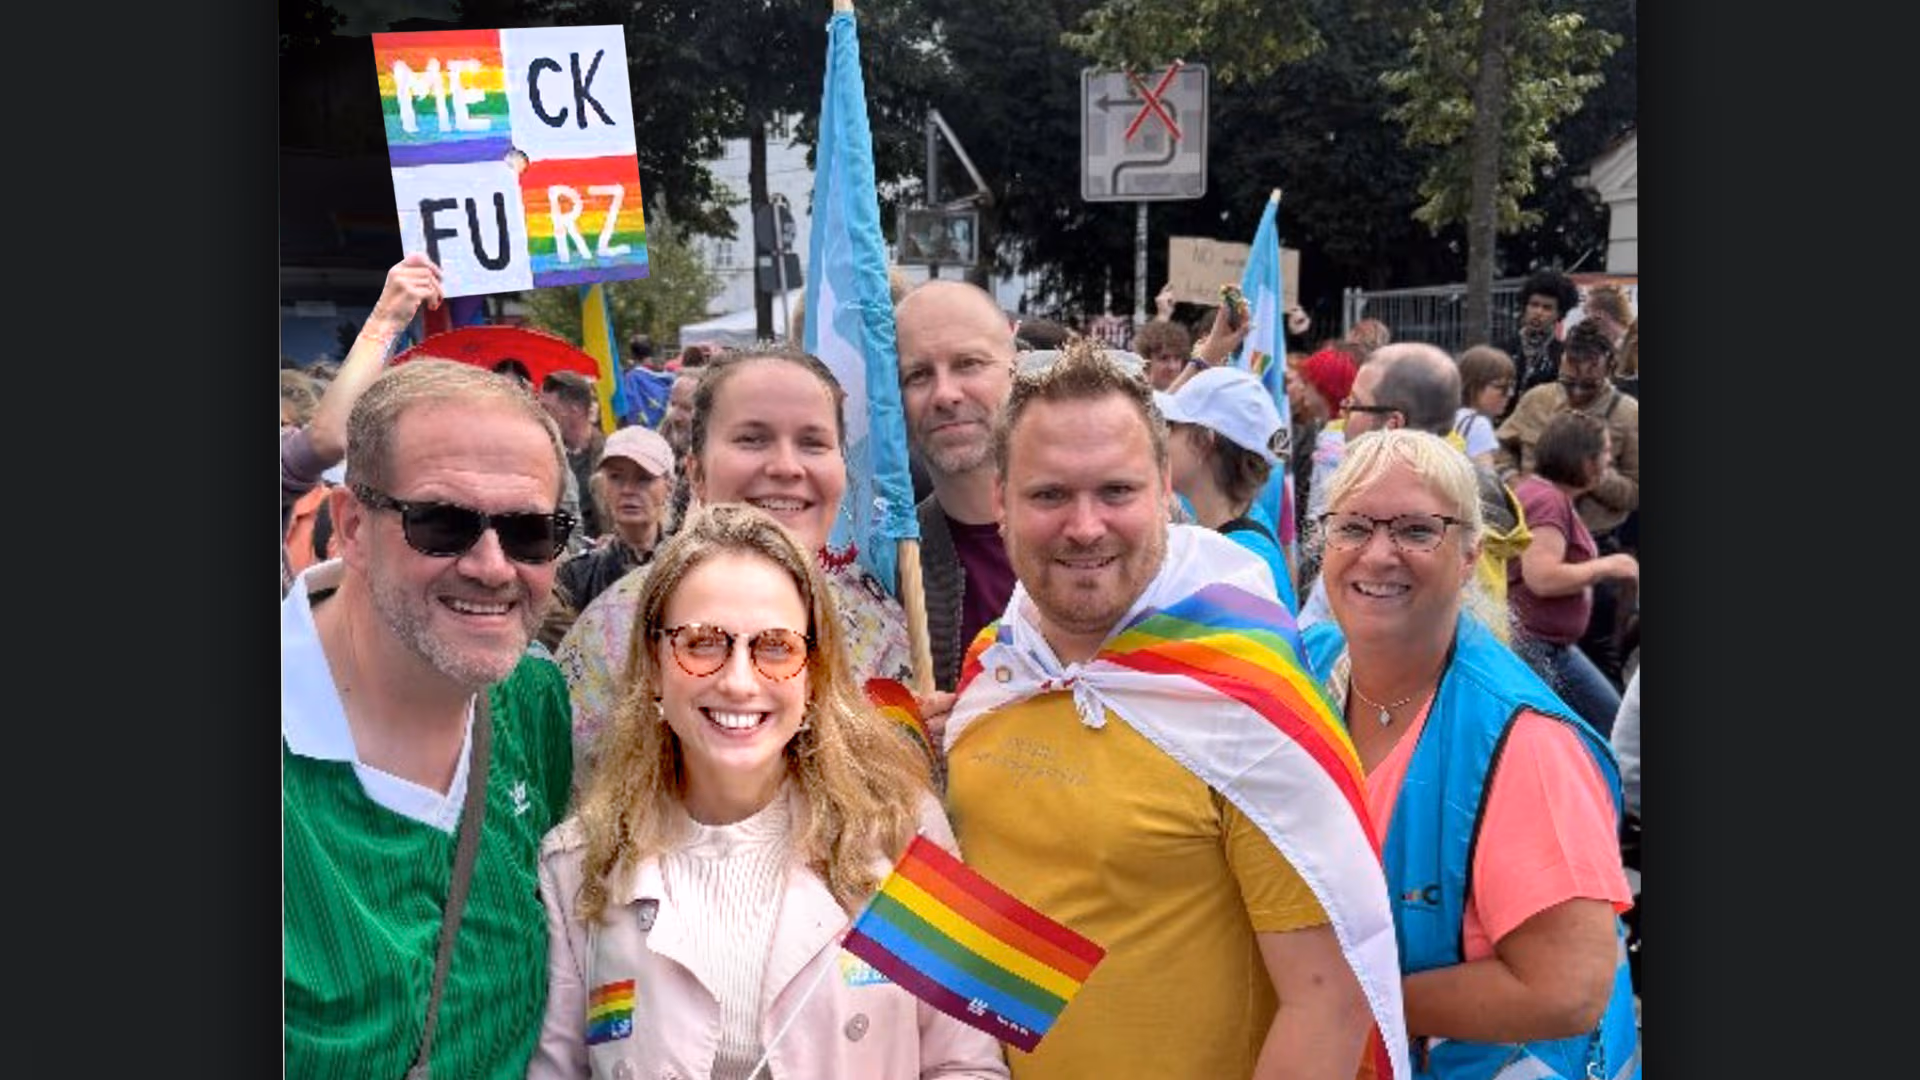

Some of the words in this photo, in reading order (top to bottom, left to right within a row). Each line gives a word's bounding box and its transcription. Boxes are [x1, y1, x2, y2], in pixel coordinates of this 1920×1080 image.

[393, 57, 491, 132] ME
[527, 49, 616, 130] CK
[418, 192, 511, 271] FU
[548, 184, 631, 263] RZ
